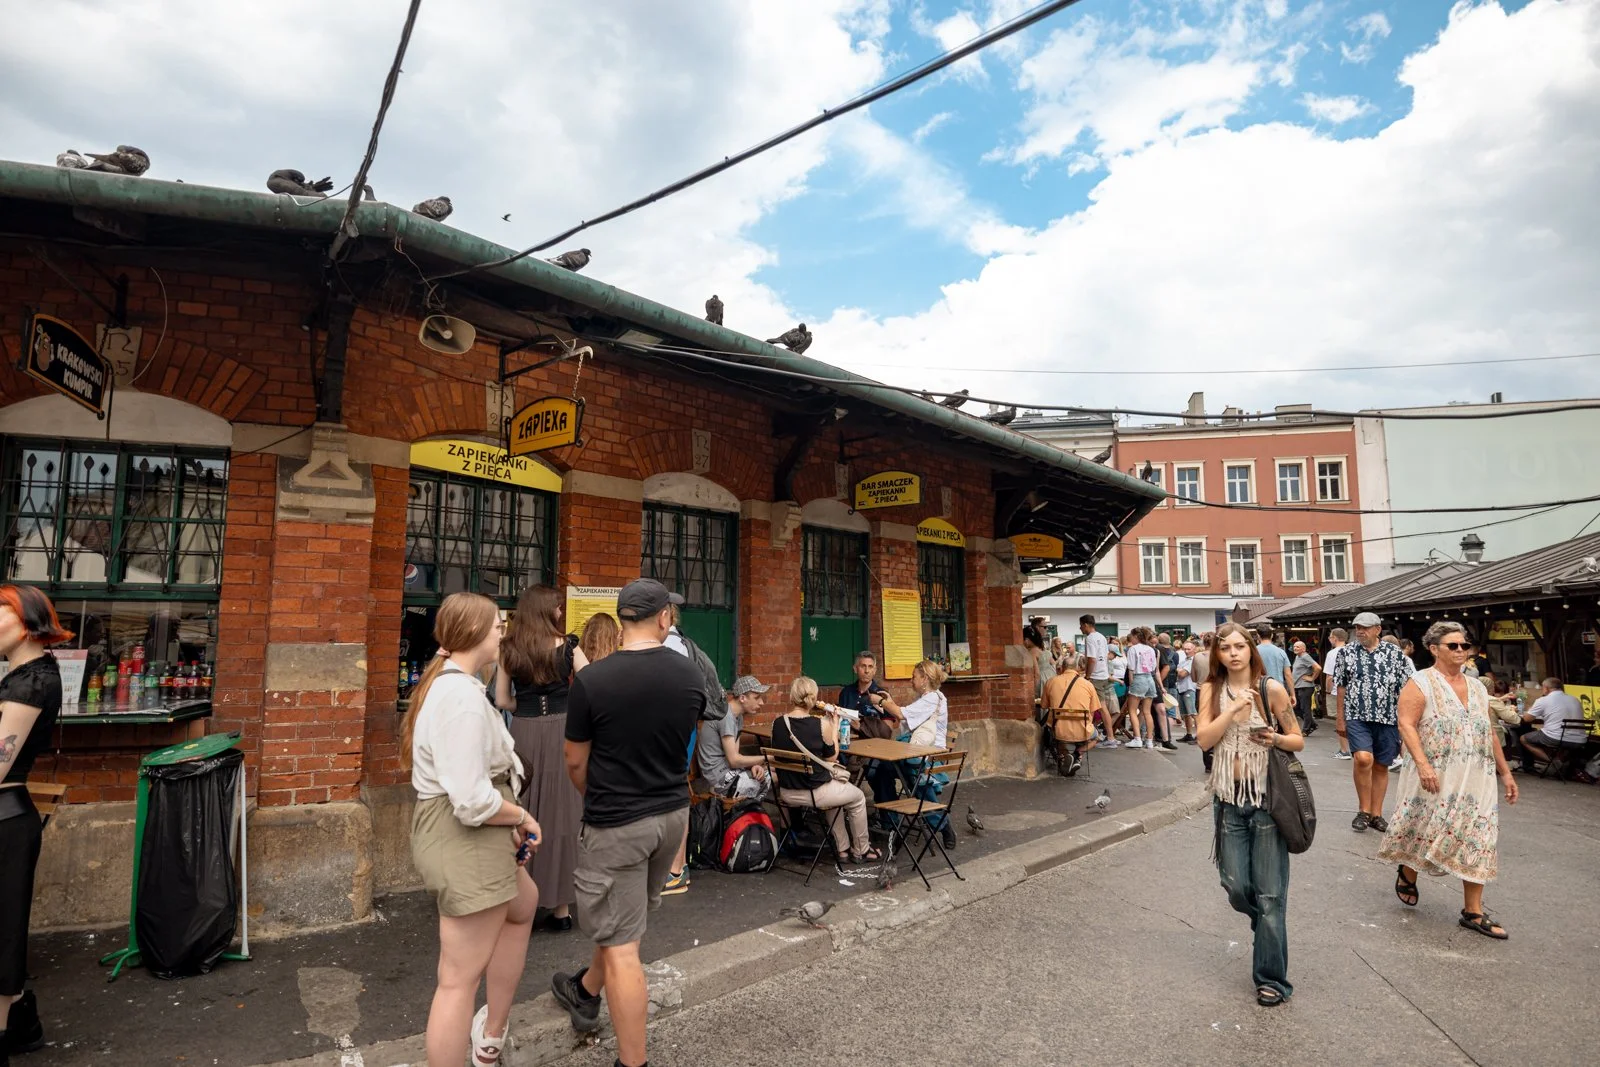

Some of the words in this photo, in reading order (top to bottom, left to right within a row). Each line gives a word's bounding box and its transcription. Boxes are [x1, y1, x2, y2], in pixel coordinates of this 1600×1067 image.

[57, 343, 103, 386] KRAKOWSKI
[63, 369, 93, 399] KUMPIR
[448, 444, 528, 471] ZAPIEKANKI
[695, 454, 709, 468] 27
[461, 460, 471, 472] Z
[474, 462, 512, 480] PIECA
[862, 482, 876, 490] BAR
[878, 478, 913, 488] SMACZEK
[868, 487, 906, 497] ZAPIEKANKI
[943, 530, 946, 539] Z
[947, 531, 960, 541] PIECA
